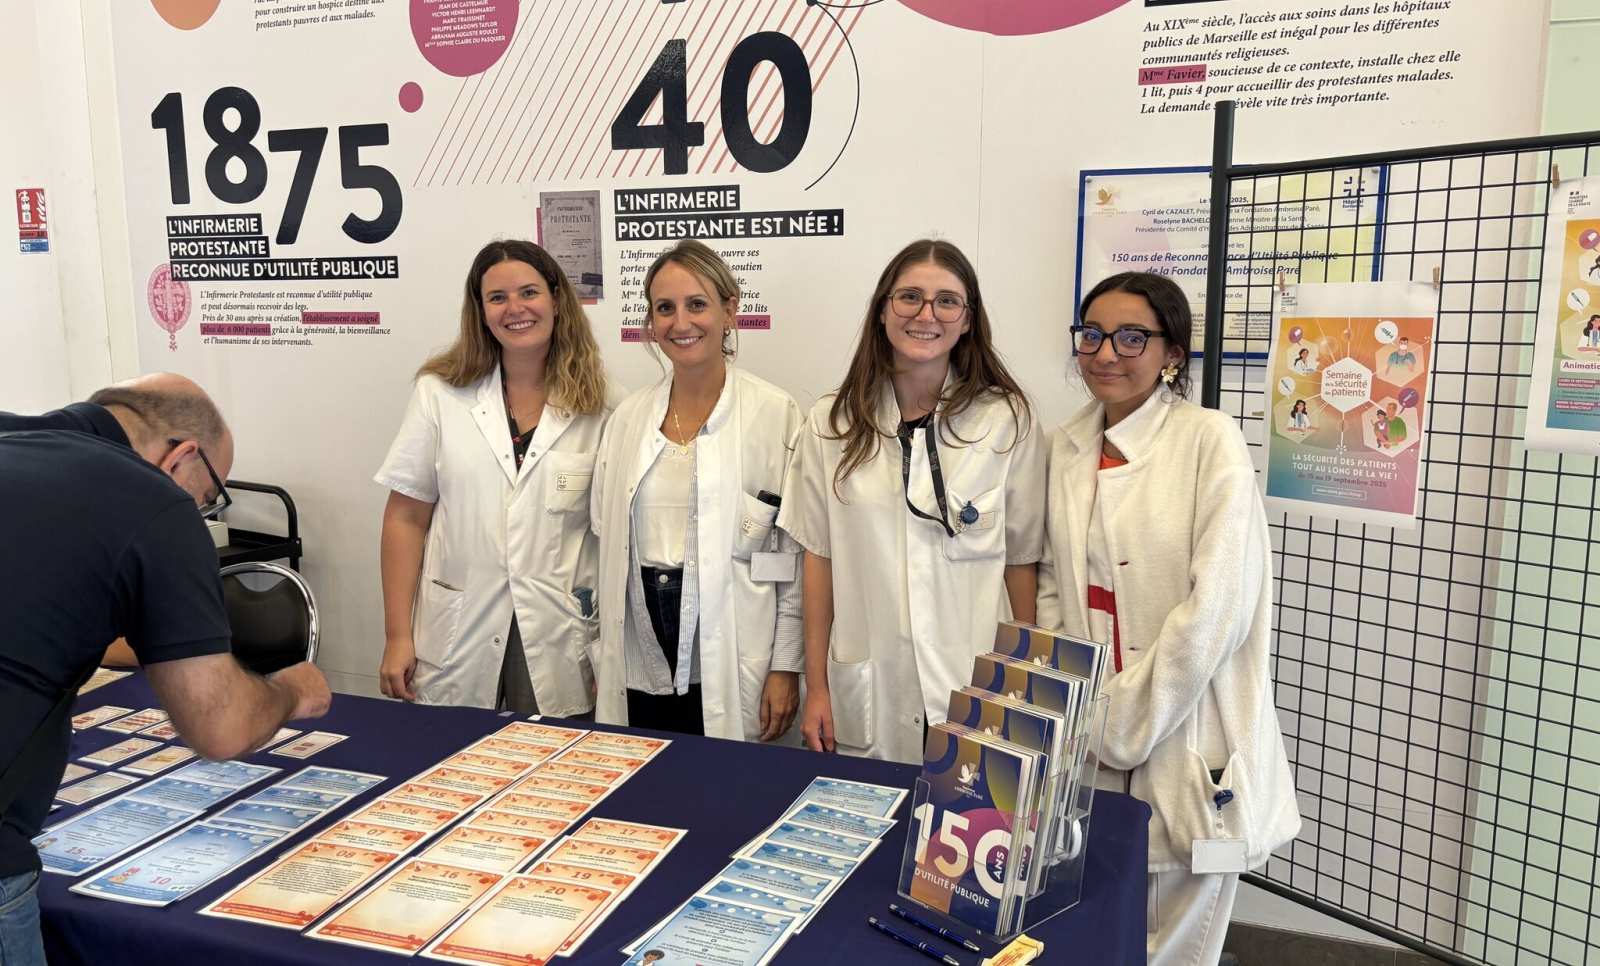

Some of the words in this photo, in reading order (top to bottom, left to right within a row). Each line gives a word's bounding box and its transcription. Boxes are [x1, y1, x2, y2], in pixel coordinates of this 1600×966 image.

[255, 9, 270, 18] pour
[272, 5, 306, 14] construire
[318, 1, 343, 11] hospice
[1143, 22, 1160, 32] Au
[1202, 15, 1236, 28] siècle,
[1239, 12, 1276, 24] l'accès
[1280, 11, 1302, 21] aux
[1305, 8, 1336, 19] soins
[1340, 5, 1370, 16] dans
[1374, 3, 1389, 14] les
[1392, 0, 1450, 14] hôpitaux
[256, 17, 292, 31] protestants
[293, 16, 320, 28] pauvres
[321, 14, 328, 22] et
[344, 10, 376, 20] malades.
[1142, 36, 1182, 52] publics
[1186, 34, 1200, 46] de
[1202, 30, 1258, 44] Marseille
[1261, 29, 1277, 40] est
[1280, 25, 1318, 40] inégal
[1320, 25, 1350, 38] pour
[1354, 22, 1370, 33] les
[1372, 18, 1440, 34] différentes
[1142, 50, 1222, 65] communautés
[1226, 46, 1290, 62] religieuses.
[1167, 69, 1205, 80] Favier,
[1208, 65, 1264, 78] soucieuse
[1270, 62, 1281, 73] de
[1284, 64, 1296, 72] ce
[1300, 59, 1354, 71] contexte,
[1358, 54, 1404, 68] installe
[1407, 52, 1436, 64] chez
[1438, 50, 1461, 62] elle
[1142, 88, 1147, 98] 1
[1150, 86, 1166, 98] lit,
[1168, 86, 1192, 99] puis
[1196, 85, 1202, 95] 4
[1204, 85, 1234, 97] pour
[1236, 78, 1292, 92] accueillir
[1296, 77, 1314, 88] des
[1318, 74, 1393, 90] protestantes
[1397, 69, 1454, 82] malades.
[611, 31, 812, 175] 40
[1140, 104, 1155, 114] La
[1158, 100, 1211, 113] demande
[1234, 98, 1262, 109] évèle
[1266, 96, 1288, 106] vite
[1290, 94, 1313, 106] très
[1316, 91, 1390, 106] importante.
[151, 86, 403, 245] 1875
[617, 190, 736, 210] L'INFIRMERIE
[168, 217, 259, 234] L'INFIRMERIE
[550, 215, 592, 223] PROTESTANTE
[618, 218, 745, 238] PROTESTANTE
[751, 218, 783, 235] EST
[790, 212, 828, 234] NÉE
[834, 216, 838, 232] !
[170, 239, 266, 257] PROTESTANTE
[1112, 254, 1128, 262] 150
[1150, 253, 1162, 261] de
[172, 260, 250, 278] RECONNUE
[253, 258, 319, 278] D'UTILITÉ
[322, 259, 396, 278] PUBLIQUE
[620, 264, 646, 275] portes
[732, 262, 762, 271] soutien
[621, 277, 630, 286] de
[632, 277, 640, 286] la
[200, 290, 238, 300] L'Infirmerie
[317, 290, 342, 298] d'utilité
[344, 290, 372, 300] publique
[208, 303, 222, 312] peut
[295, 302, 308, 312] legs.
[742, 304, 753, 312] 20
[754, 304, 768, 312] lits
[247, 314, 264, 324] après
[274, 314, 302, 322] création,
[357, 314, 378, 324] soigné
[202, 326, 216, 334] plus
[246, 326, 270, 335] patients
[272, 326, 289, 336] grâce
[304, 326, 338, 336] générosité,
[347, 326, 390, 334] bienveillance
[1326, 370, 1362, 379] Semaine
[1332, 388, 1365, 396] patients
[1334, 380, 1367, 388] sécurité
[1304, 454, 1337, 464] SÉCURITÉ
[1358, 460, 1396, 470] PATIENTS
[1328, 466, 1350, 474] LONG
[65, 846, 86, 854] 15
[914, 802, 1012, 899] 150
[993, 851, 1005, 880] ANS
[150, 876, 172, 884] 10
[440, 870, 460, 878] 16
[571, 872, 592, 880] 19
[545, 886, 566, 895] 20
[915, 866, 949, 889] D'UTILITÉ
[950, 884, 990, 908] PUBLIQUE
